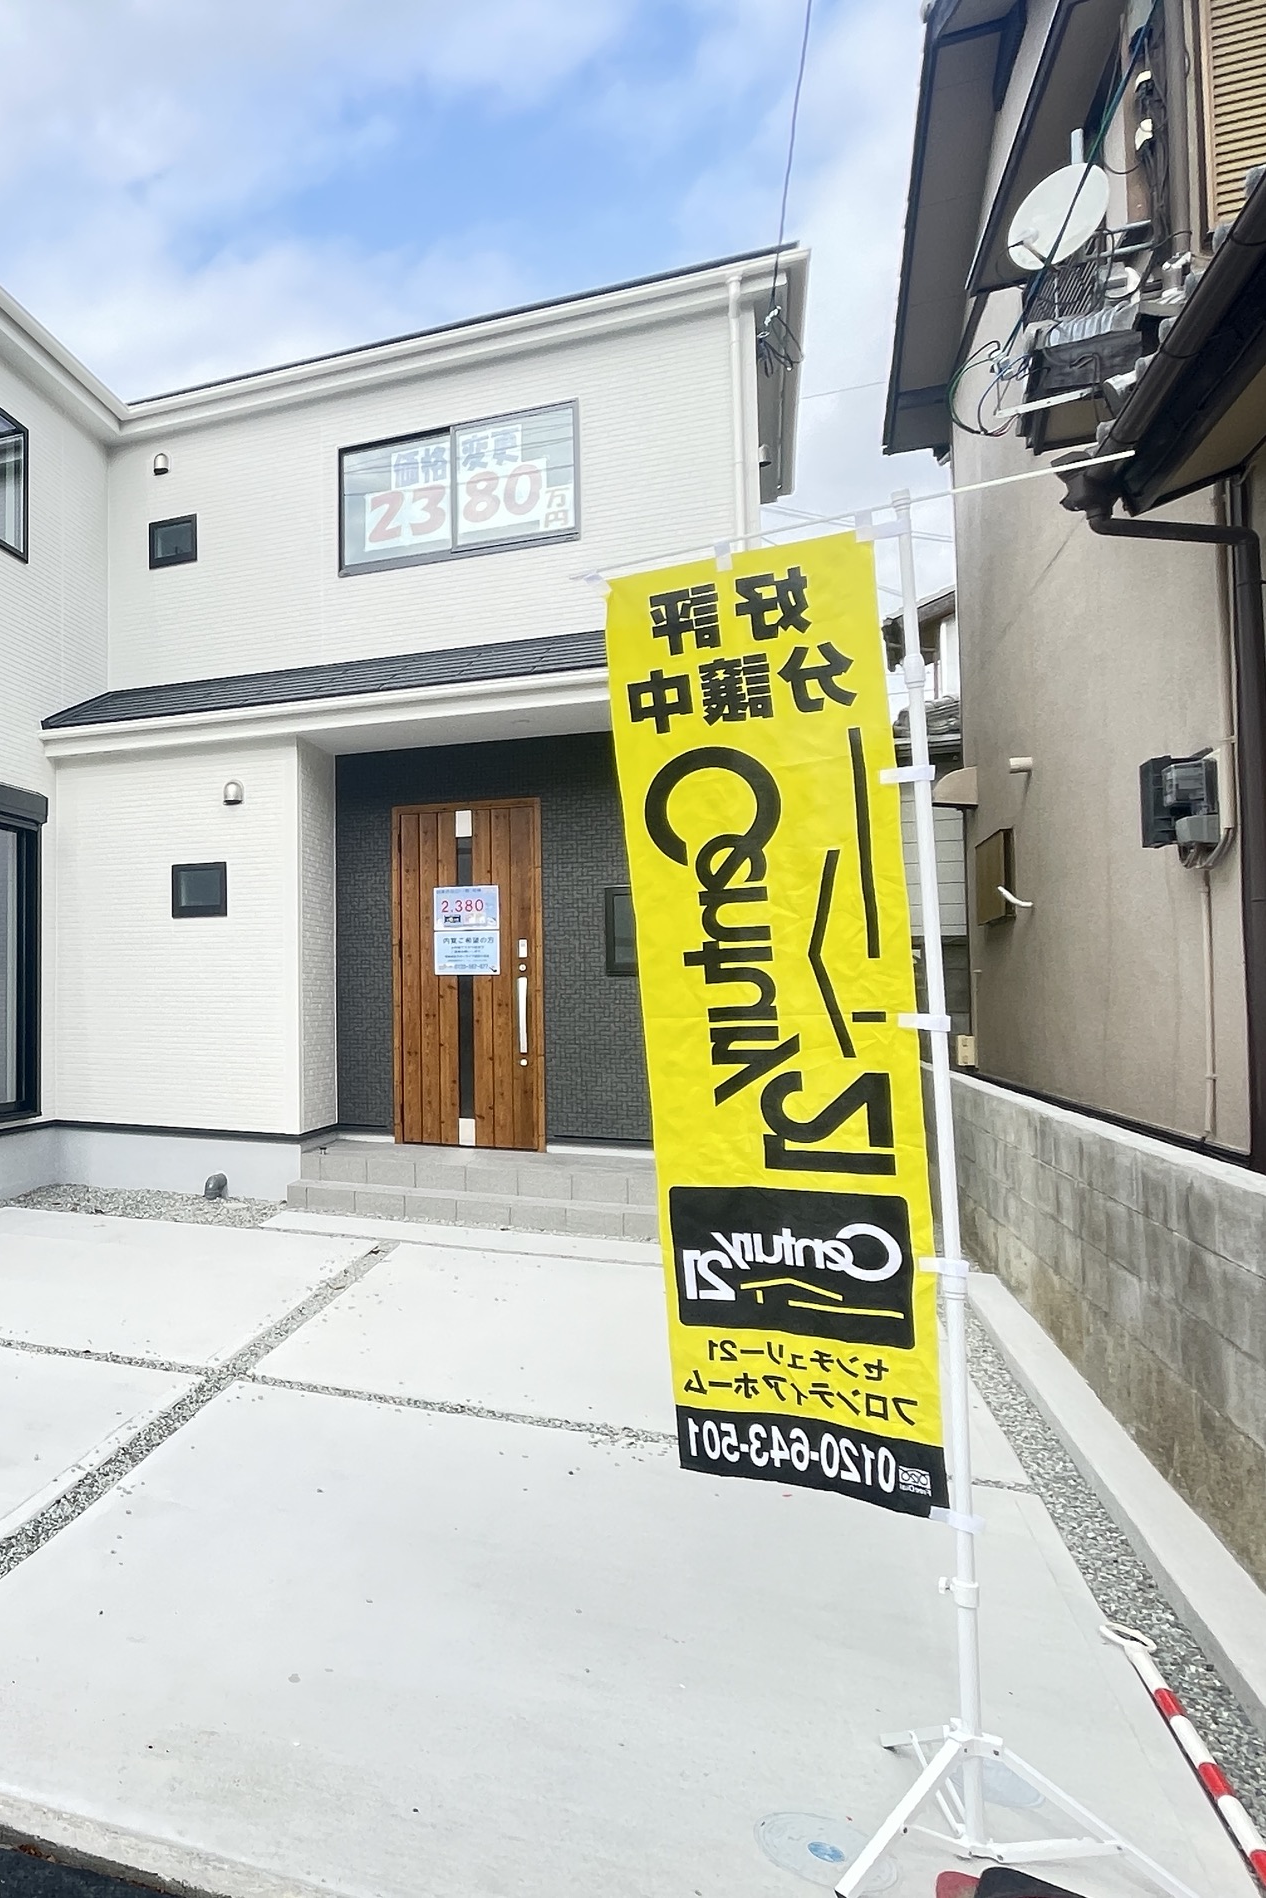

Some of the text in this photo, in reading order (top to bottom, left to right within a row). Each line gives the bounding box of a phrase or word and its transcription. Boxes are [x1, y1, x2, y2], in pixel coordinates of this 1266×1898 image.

[393, 427, 520, 487] 価格変更
[368, 464, 569, 543] 2380 万円
